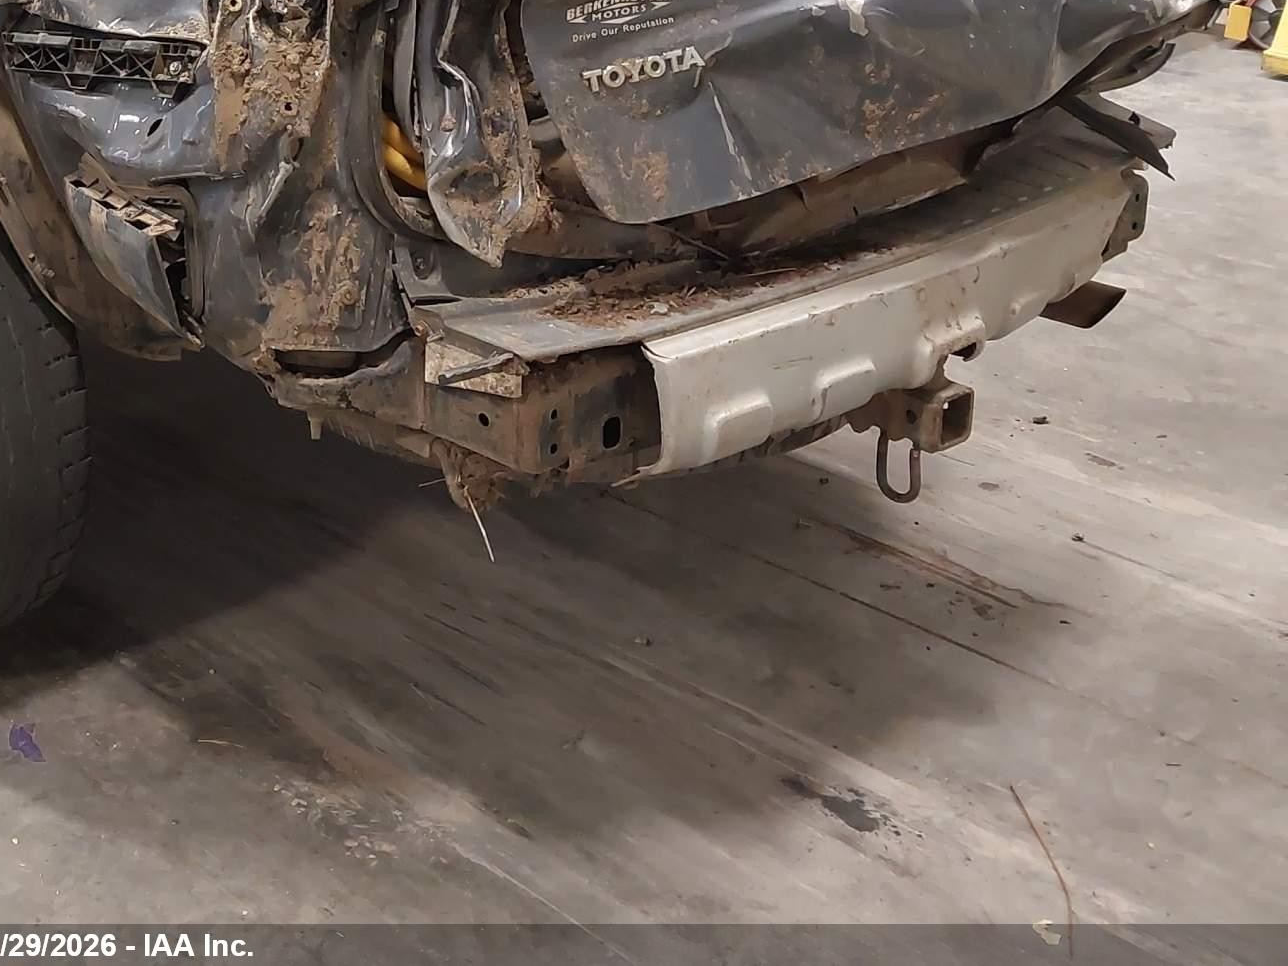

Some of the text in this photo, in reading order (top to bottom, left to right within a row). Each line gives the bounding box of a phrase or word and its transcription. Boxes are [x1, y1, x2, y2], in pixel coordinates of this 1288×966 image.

[592, 2, 647, 22] MOTORS
[572, 16, 675, 43] Drive Our Reputation
[582, 45, 706, 92] TOYOTA
